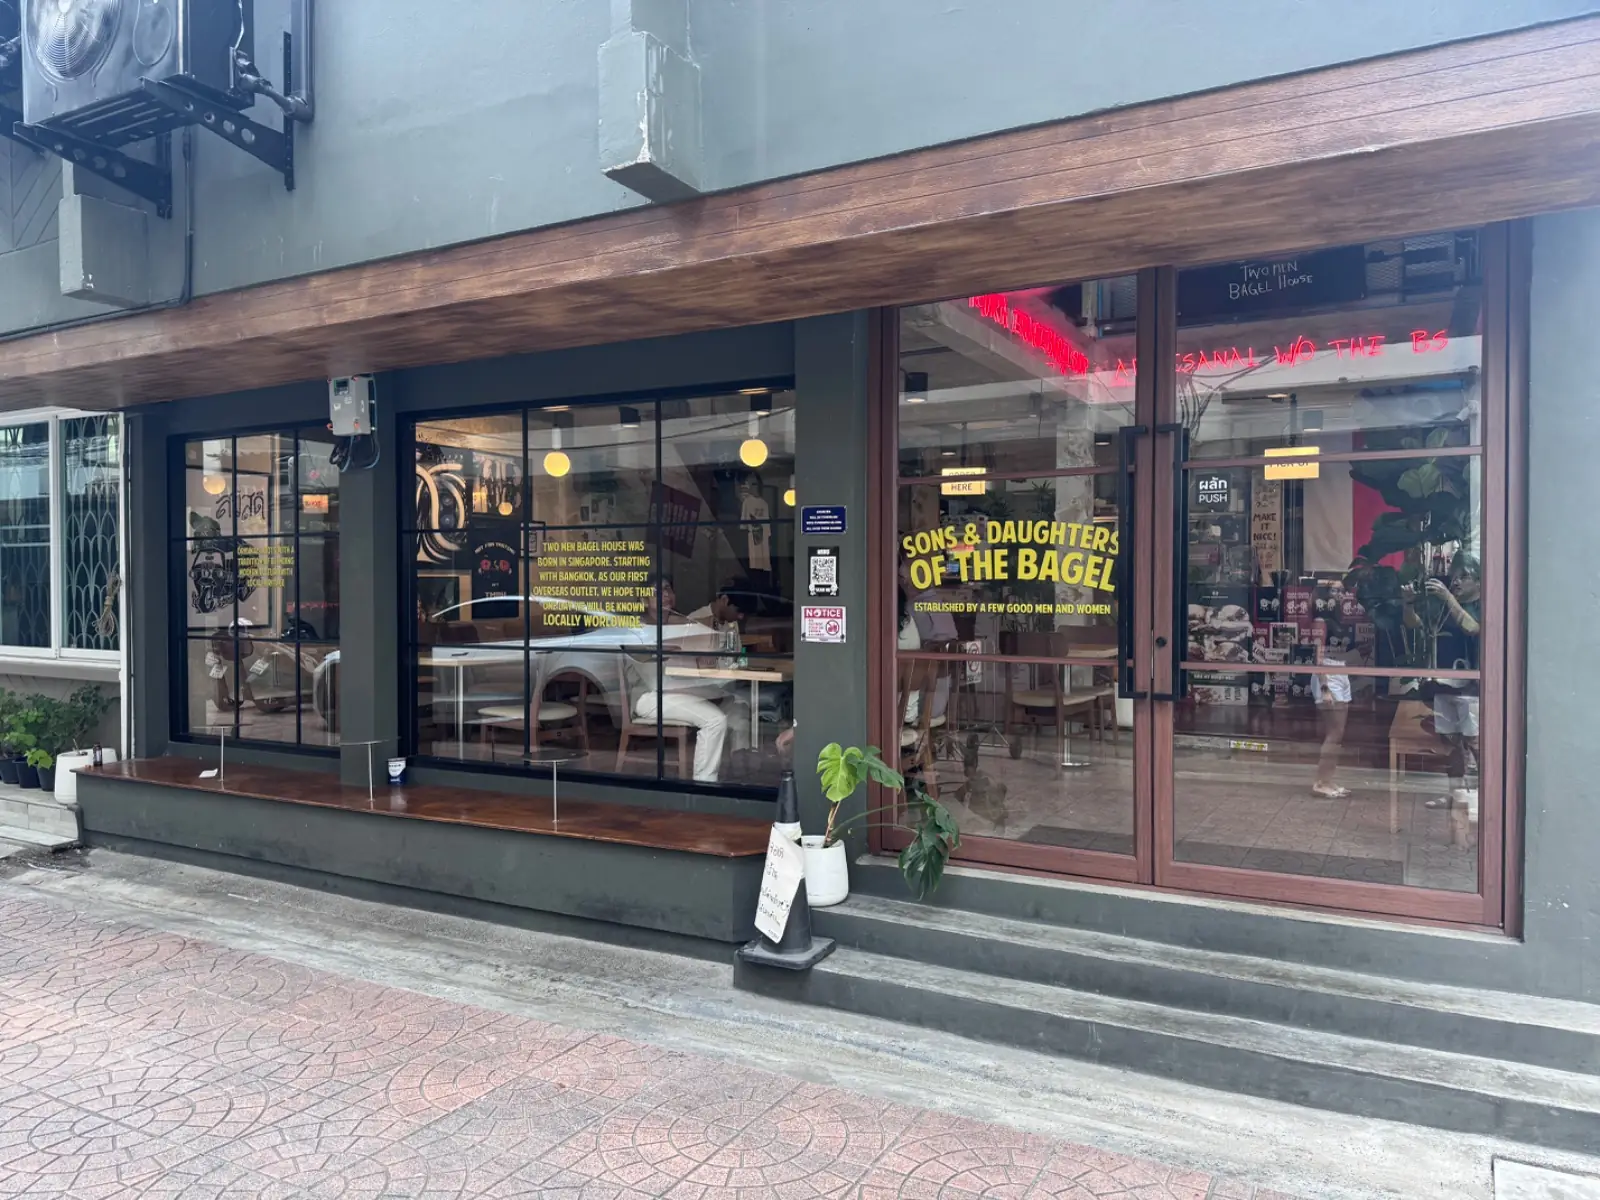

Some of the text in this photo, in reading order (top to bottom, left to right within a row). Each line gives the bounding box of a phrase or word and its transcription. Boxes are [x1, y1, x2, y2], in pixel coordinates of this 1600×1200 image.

[1229, 280, 1272, 300] BAGEL
[1410, 329, 1449, 354] BS
[951, 482, 973, 492] HERE
[1199, 476, 1228, 490] ผลัก
[1199, 493, 1228, 504] PUSH
[1253, 513, 1277, 521] MAKE
[902, 520, 1119, 559] SONS & DAUGHTERS
[543, 541, 645, 552] TWO MEN BAGEL HOUSE WAS
[537, 557, 558, 567] BORN
[559, 557, 567, 567] IN
[613, 556, 650, 567] STARTING
[910, 548, 1115, 593] OF THE BAGEL
[539, 571, 648, 582] WITH BANGKOK, AS OUR FIRST
[533, 586, 568, 596] OVERSEAS
[601, 586, 612, 597] WE
[613, 587, 634, 597] HOPE
[635, 586, 656, 597] THAT
[605, 602, 615, 612] BE
[615, 602, 645, 612] KNOWN
[914, 602, 1111, 615] ESTABLISHED BY A FEW GOOD MEN AND WOMEN
[806, 609, 841, 617] NOTICE
[543, 614, 581, 626] LOCALLY
